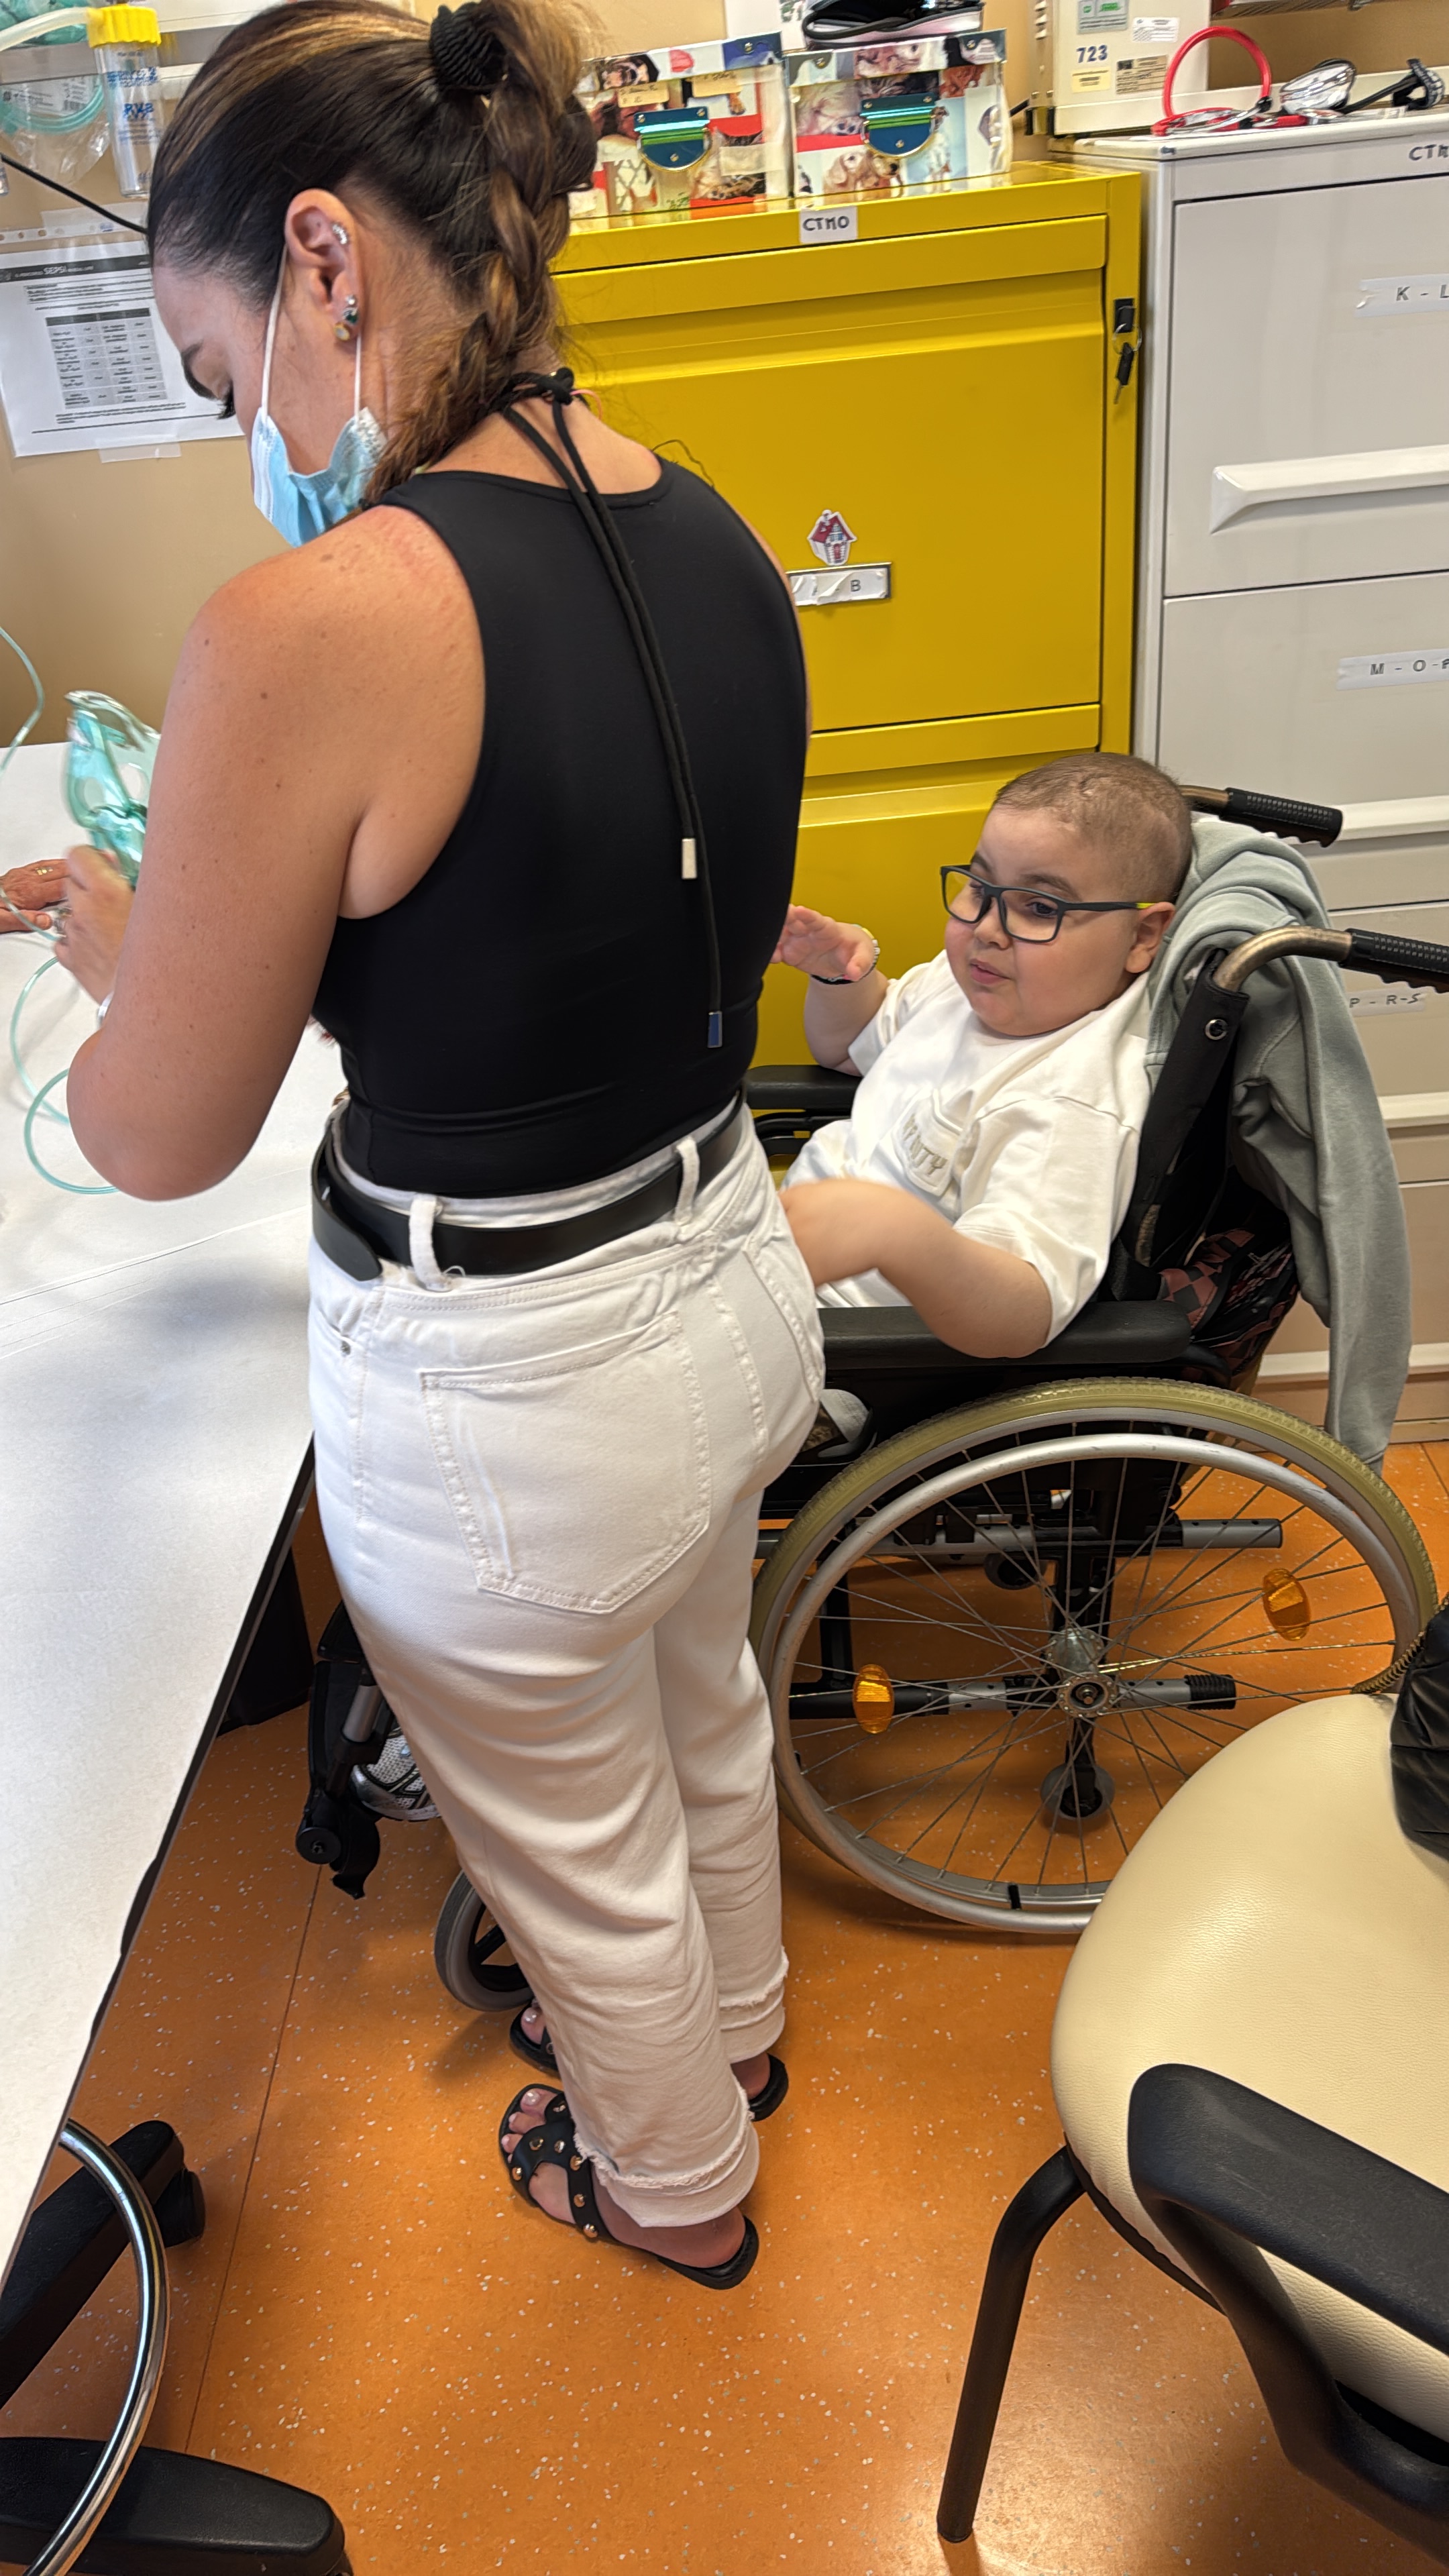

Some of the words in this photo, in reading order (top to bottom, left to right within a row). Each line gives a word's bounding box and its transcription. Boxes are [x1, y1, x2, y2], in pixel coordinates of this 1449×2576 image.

[1076, 45, 1108, 63] 723
[802, 215, 850, 231] CTMO
[1396, 286, 1410, 301] K
[1440, 284, 1449, 299] L
[850, 579, 861, 592] B
[1349, 998, 1360, 1008] P
